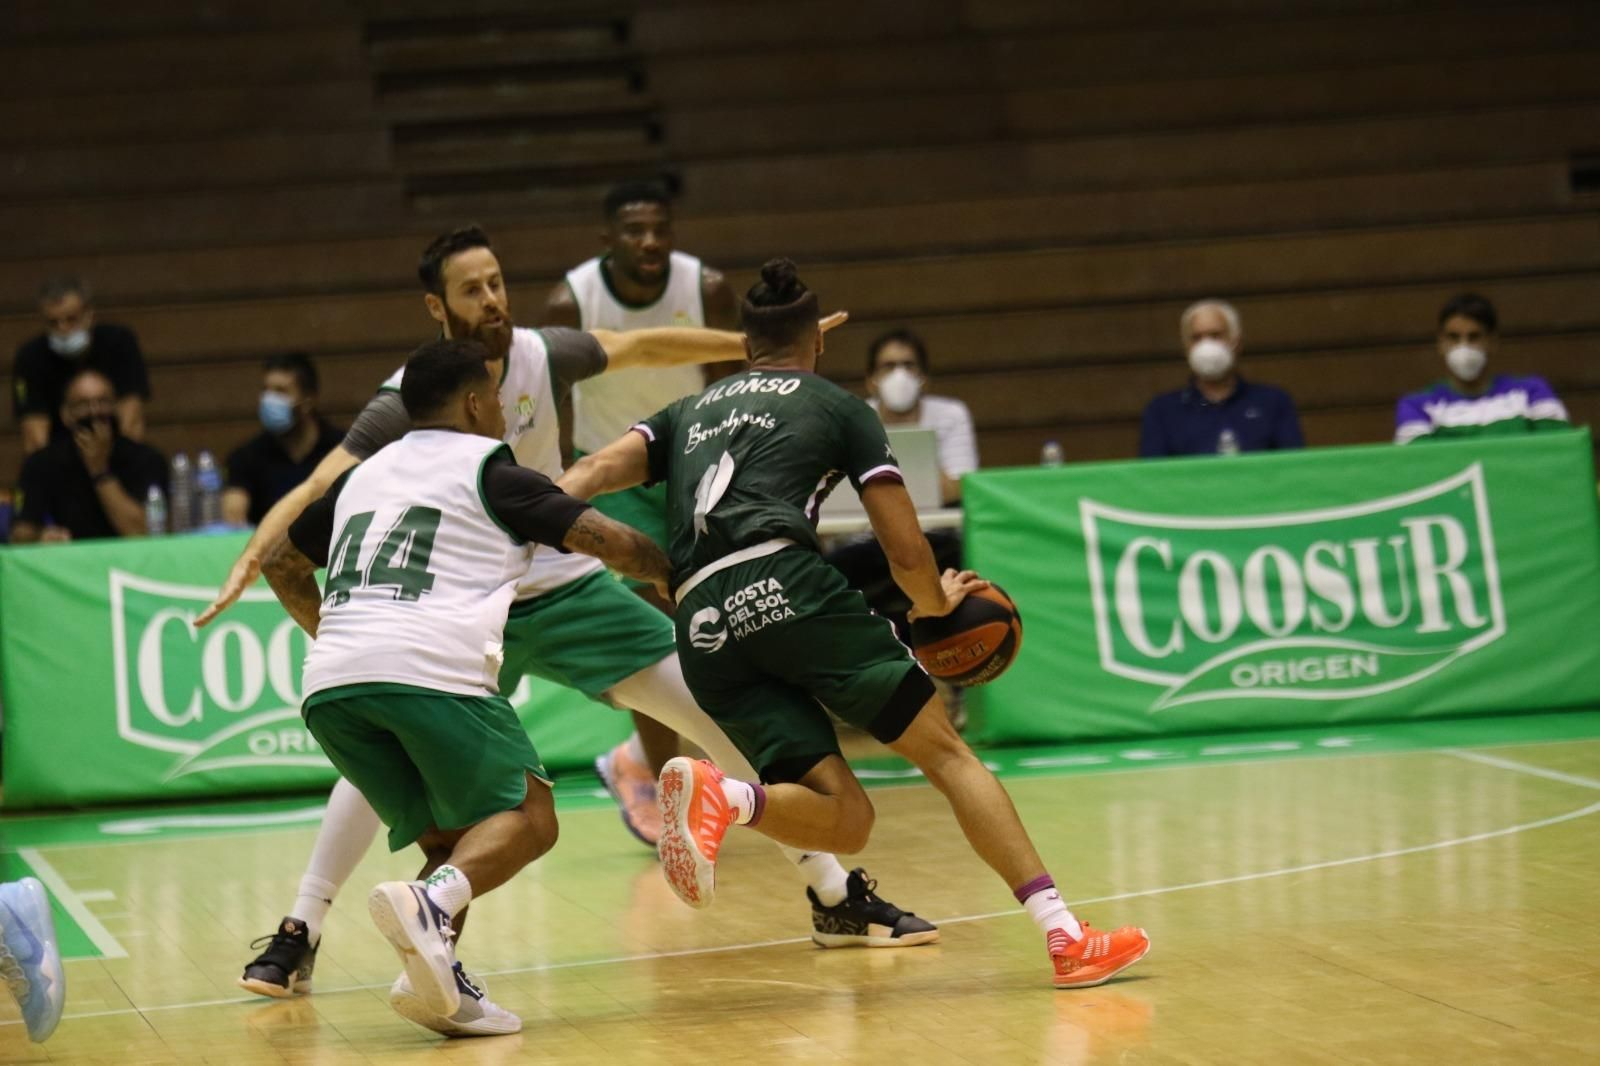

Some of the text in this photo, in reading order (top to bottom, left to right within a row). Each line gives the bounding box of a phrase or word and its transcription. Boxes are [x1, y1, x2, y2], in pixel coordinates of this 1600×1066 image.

[694, 377, 801, 410] ALONSO
[323, 506, 443, 609] 44
[723, 577, 783, 612] COSTA
[1114, 514, 1487, 659] COOSUR
[728, 593, 790, 628] DEL SOL
[137, 606, 309, 727] COO
[1230, 653, 1380, 688] ORIGEN
[248, 728, 318, 756] ORI
